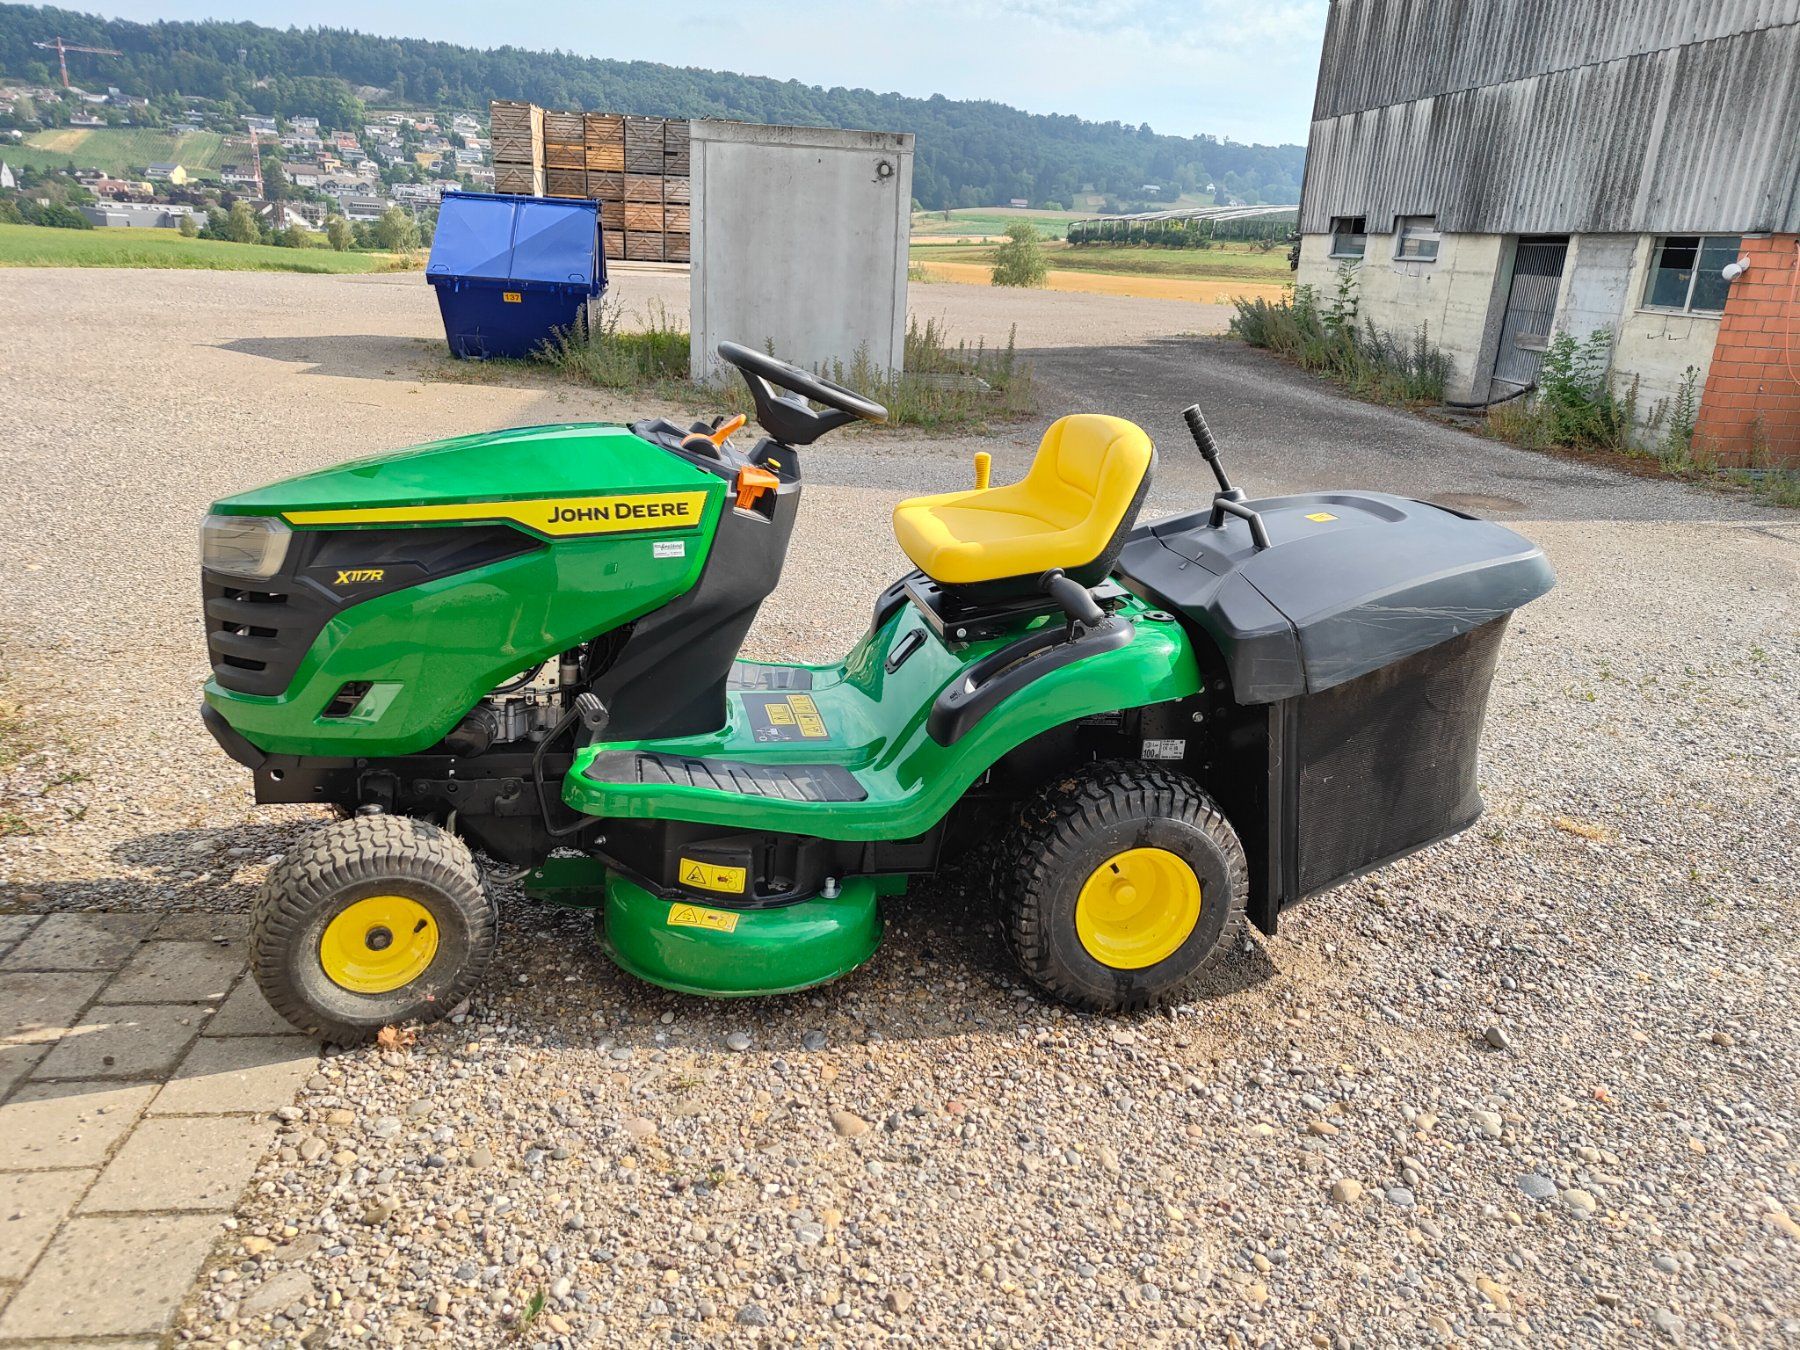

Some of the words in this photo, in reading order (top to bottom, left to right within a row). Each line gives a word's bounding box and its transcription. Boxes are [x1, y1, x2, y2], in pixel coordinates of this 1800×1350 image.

[547, 506, 609, 523] JOHN
[614, 502, 689, 519] DEERE
[334, 569, 384, 584] X117R
[1143, 749, 1154, 758] 100
